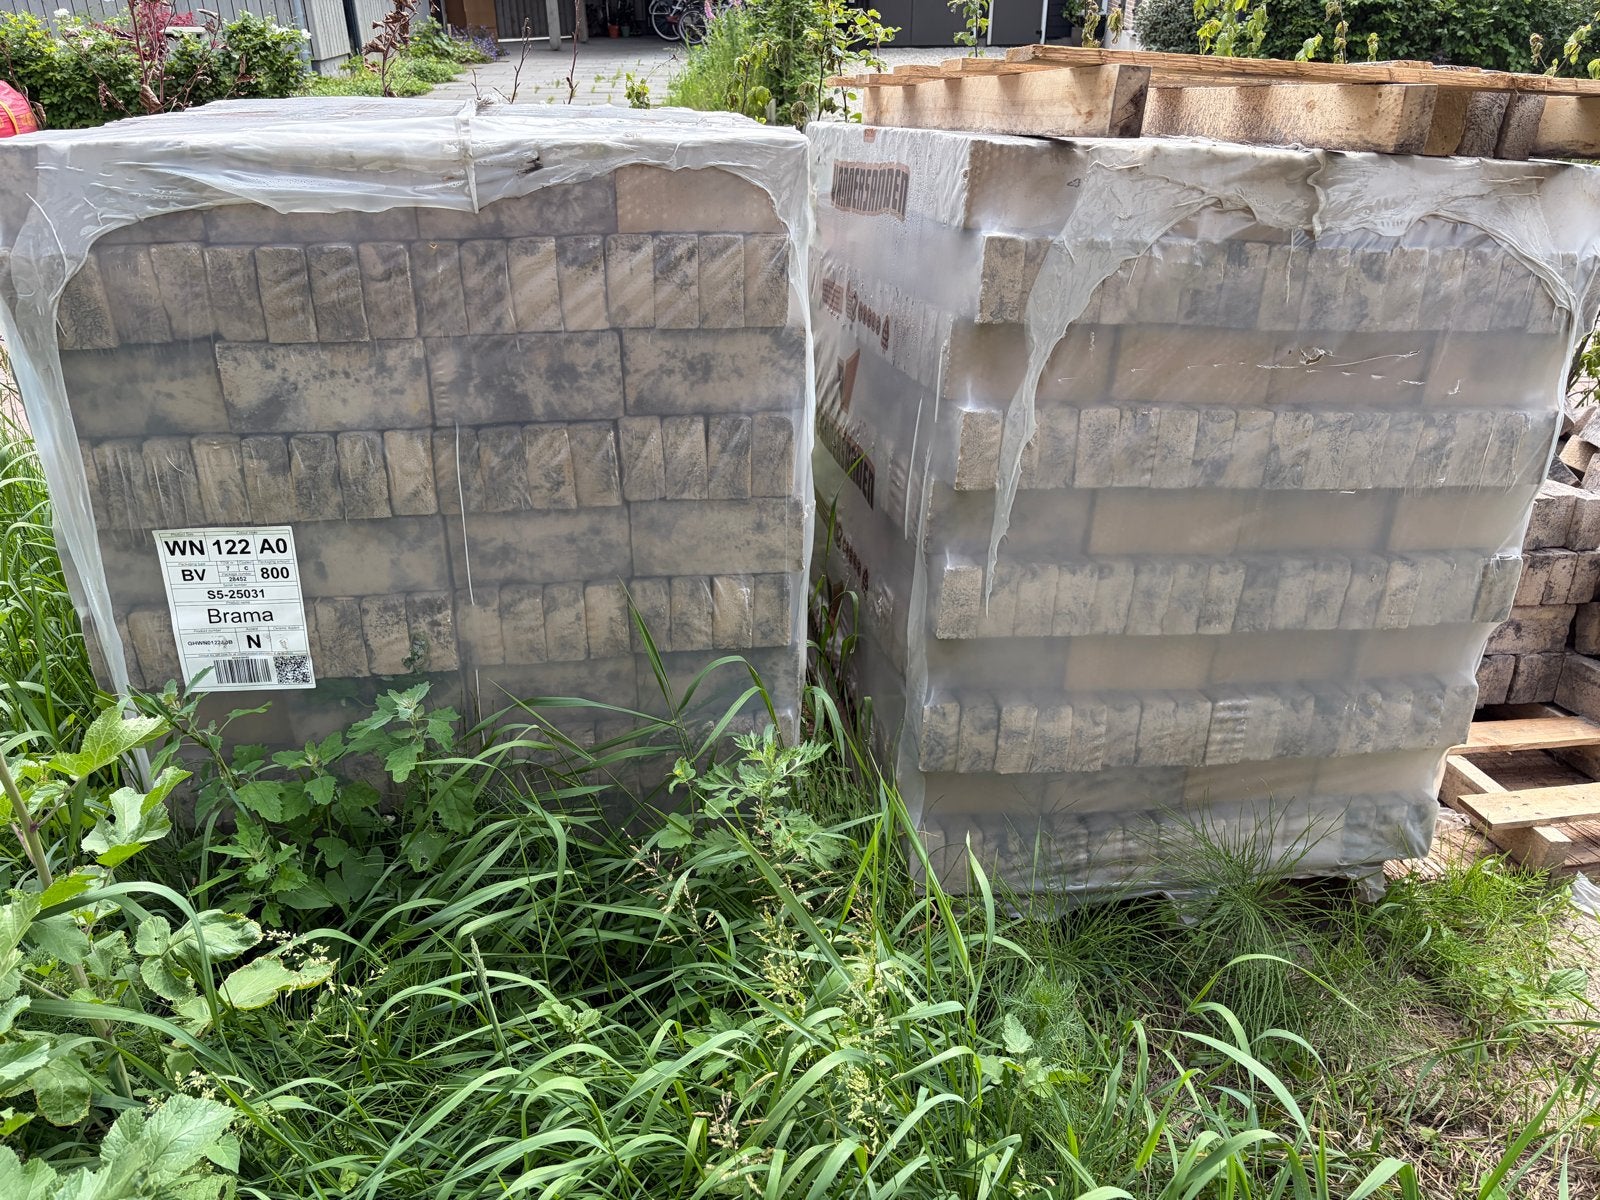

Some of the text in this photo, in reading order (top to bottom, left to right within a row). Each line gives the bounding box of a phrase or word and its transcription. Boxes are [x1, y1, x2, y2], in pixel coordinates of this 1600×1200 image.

[163, 537, 288, 556] WN 122 A0
[181, 568, 206, 582] BV
[260, 566, 290, 580] 800
[207, 588, 265, 600] S5-25031
[207, 608, 274, 624] Brama
[246, 634, 262, 649] N
